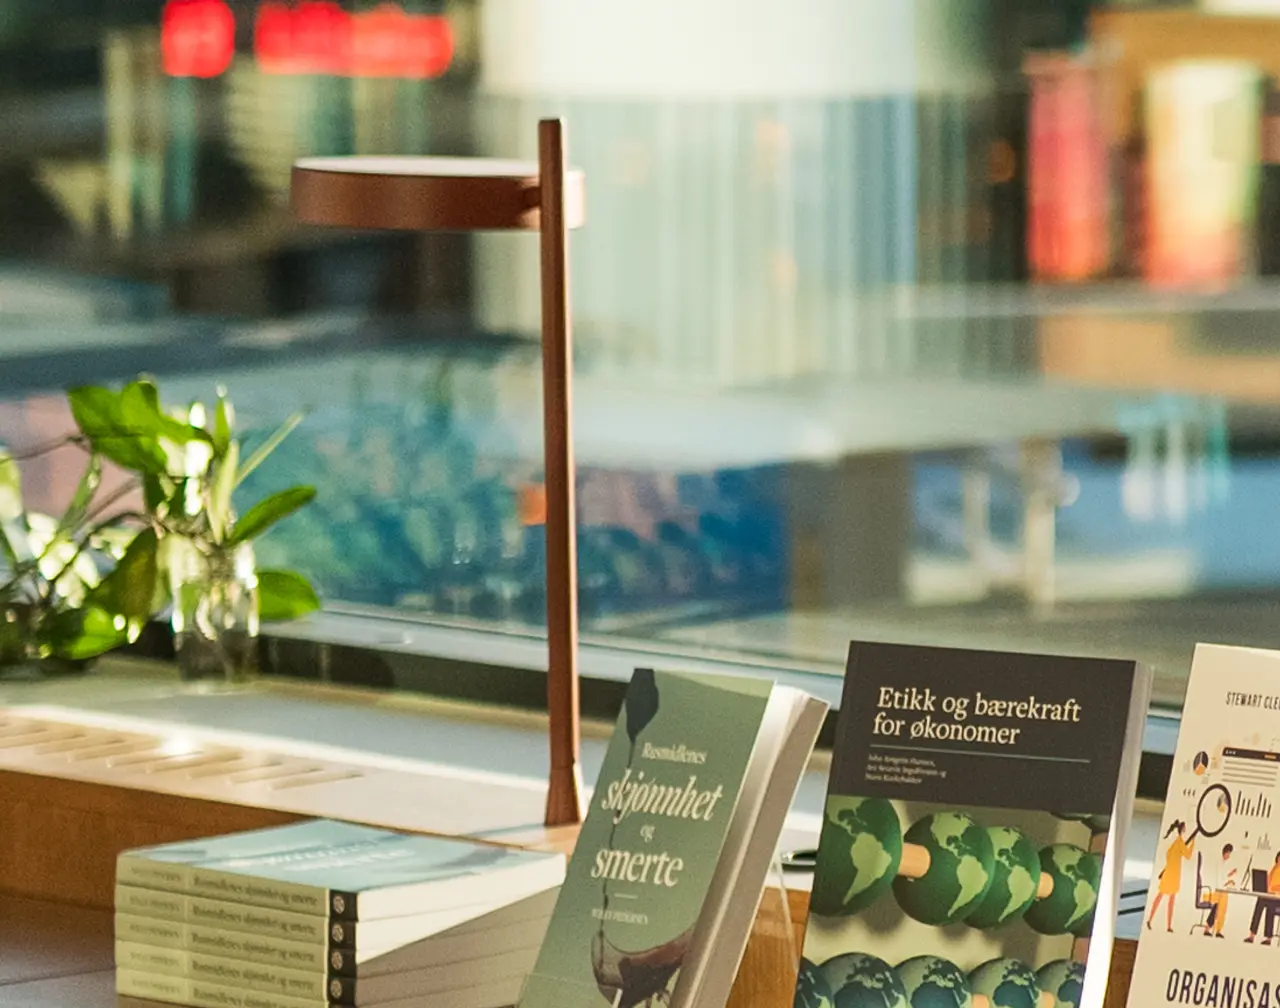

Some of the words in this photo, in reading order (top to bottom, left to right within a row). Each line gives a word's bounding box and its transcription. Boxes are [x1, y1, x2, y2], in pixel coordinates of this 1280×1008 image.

[877, 686, 937, 712] Etikk
[942, 696, 969, 721] og
[974, 692, 1082, 722] bærekraft
[1226, 692, 1262, 709] STEWART
[872, 712, 905, 736] for
[910, 715, 1020, 744] økonomer
[601, 769, 723, 824] skjønnhet
[640, 824, 656, 843] og
[591, 849, 684, 887] smerte
